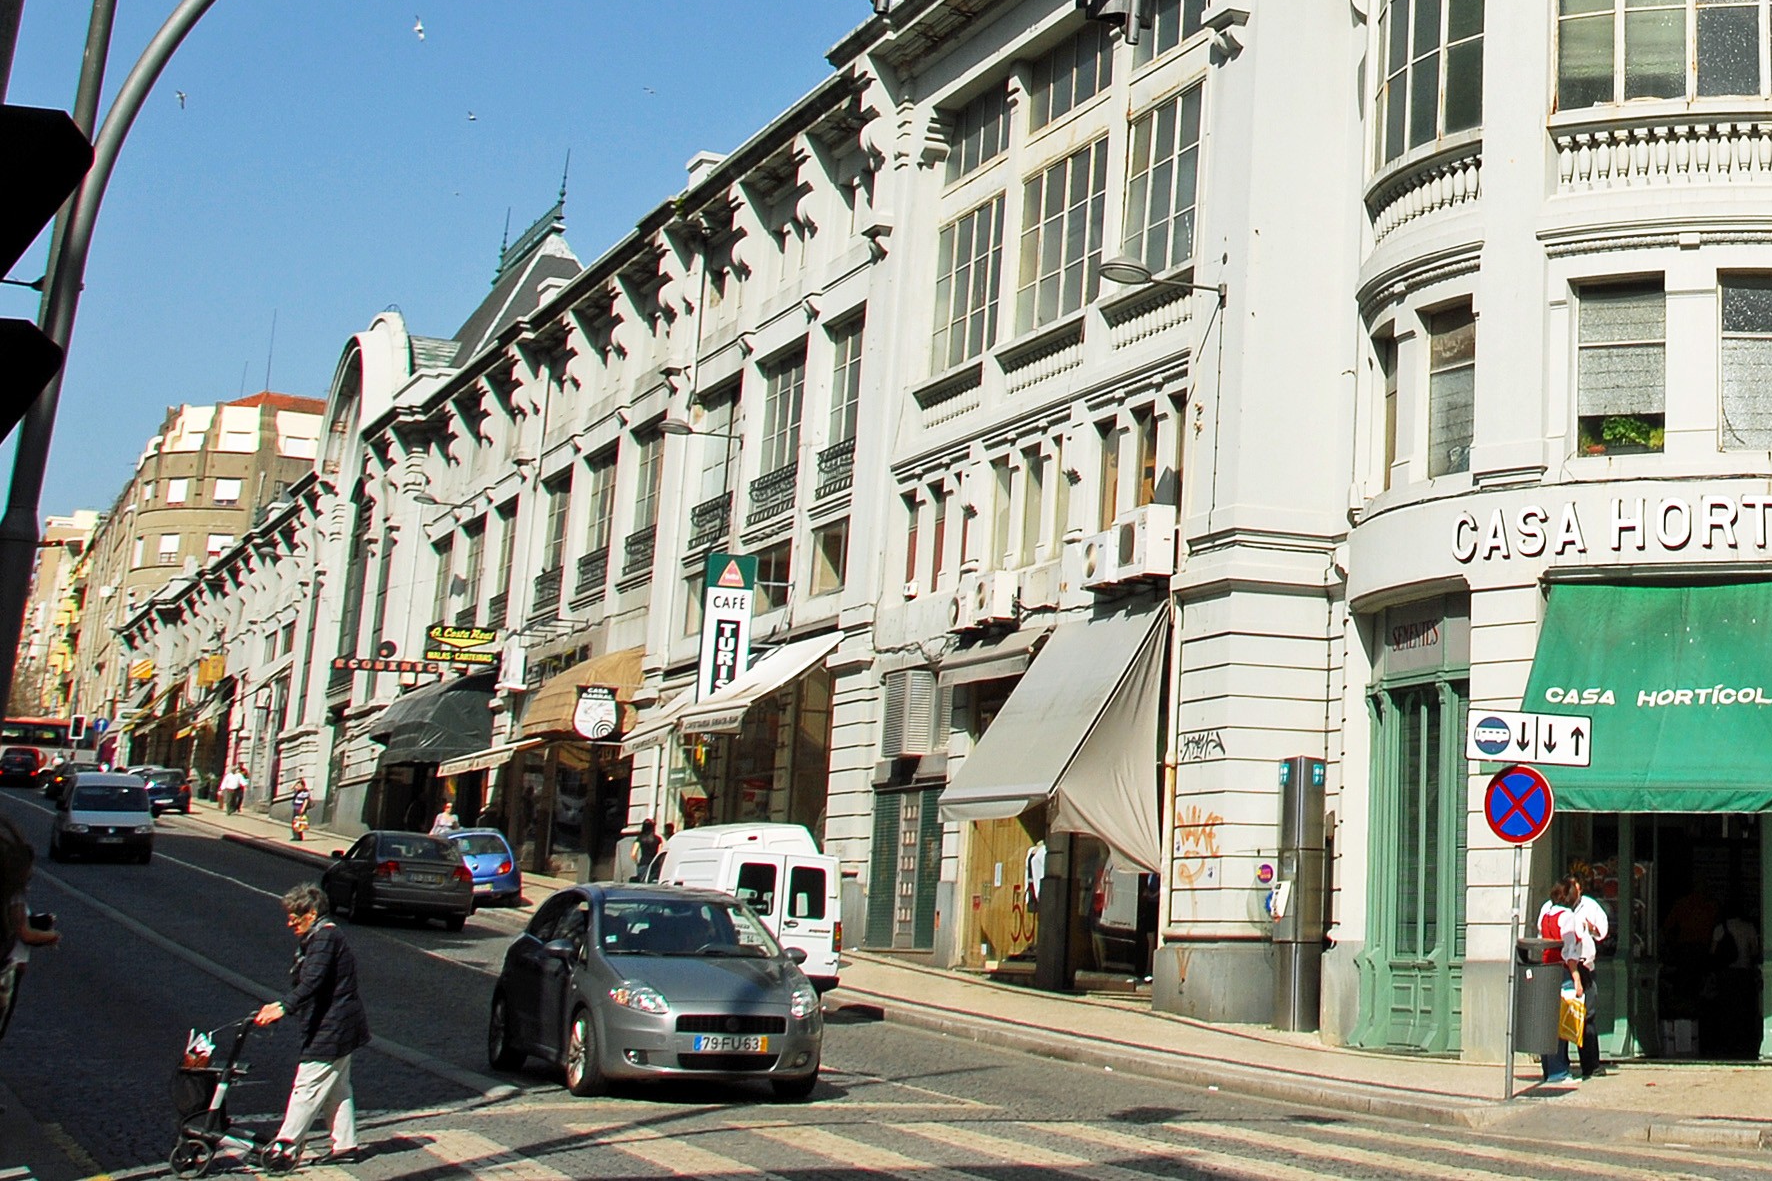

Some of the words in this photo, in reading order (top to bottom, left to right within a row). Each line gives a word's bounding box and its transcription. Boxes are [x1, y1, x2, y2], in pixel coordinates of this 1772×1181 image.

[1451, 501, 1588, 563] CASA
[713, 595, 746, 610] CAFÉ
[444, 628, 470, 639] Costa
[470, 629, 495, 640] Real
[1393, 619, 1439, 651] SEMENTES
[1545, 687, 1616, 706] CASA
